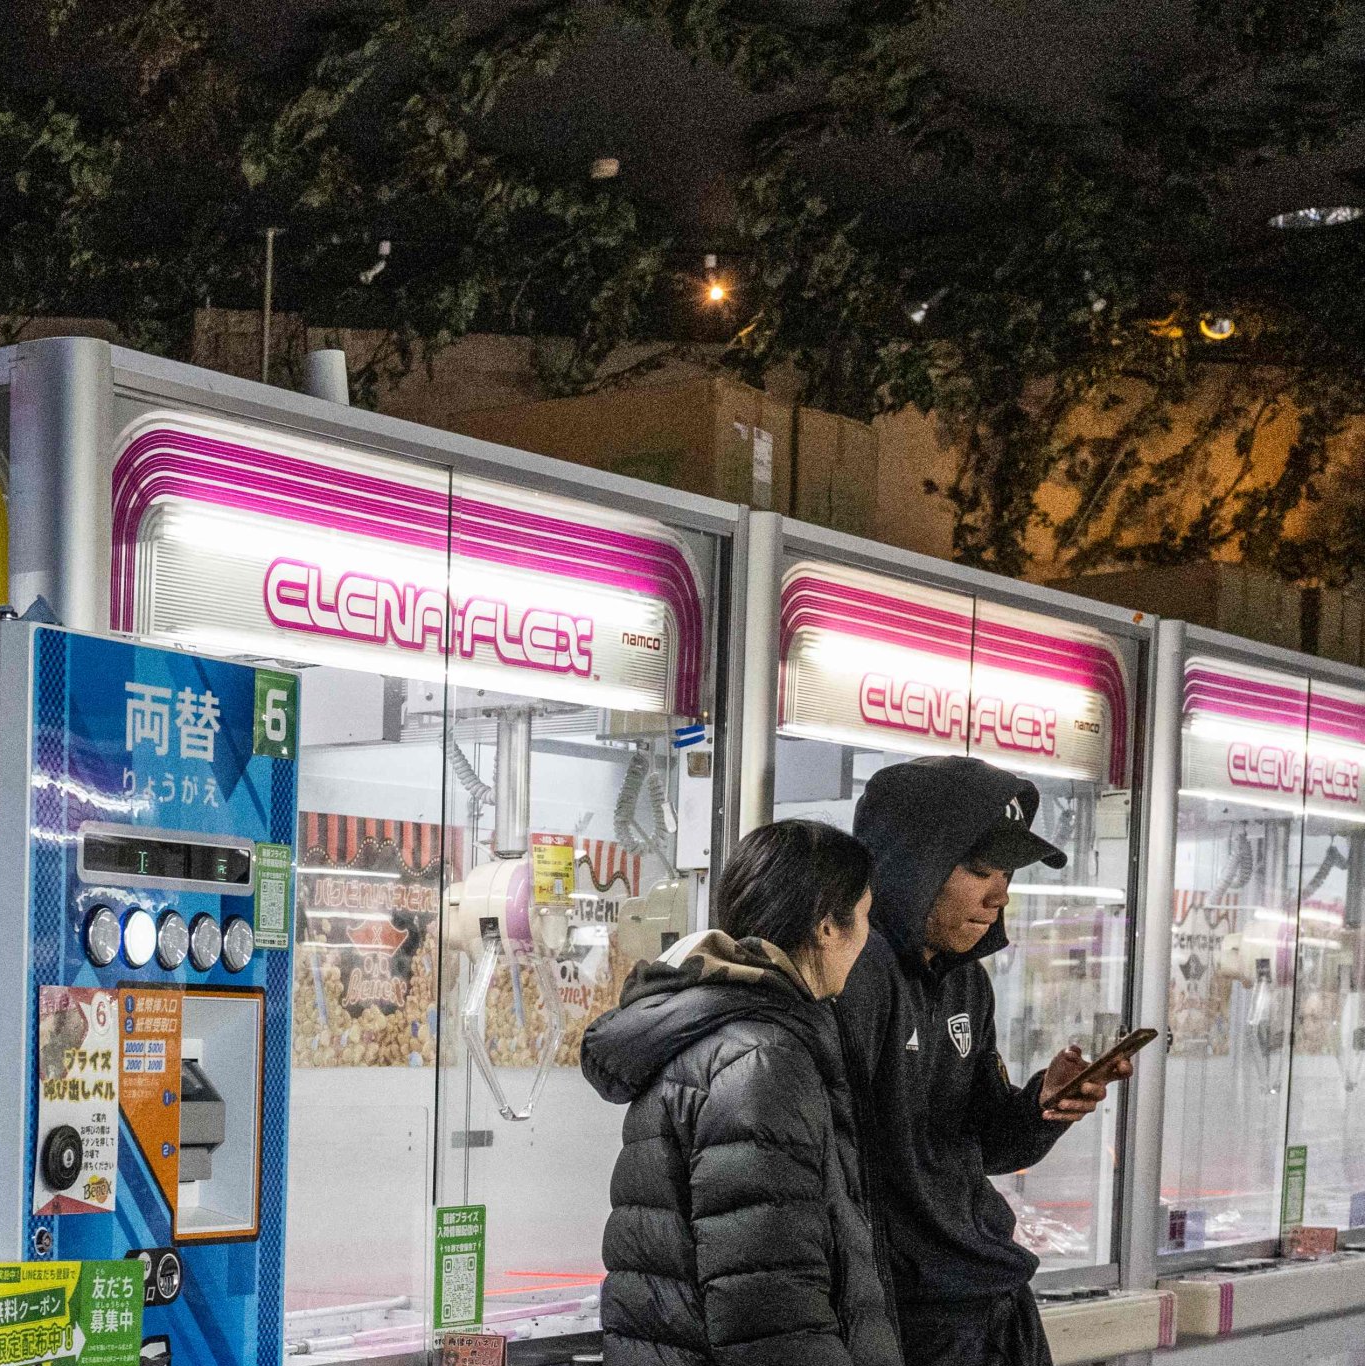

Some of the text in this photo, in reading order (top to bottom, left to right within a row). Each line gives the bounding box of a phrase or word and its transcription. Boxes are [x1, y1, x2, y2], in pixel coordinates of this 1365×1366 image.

[621, 631, 662, 652] namco
[124, 681, 221, 763] 両替
[265, 688, 288, 742] 6
[1073, 719, 1100, 734] namco
[122, 766, 219, 808] りょうがえ
[96, 1001, 107, 1027] 6
[125, 1042, 144, 1053] 10000
[64, 1049, 112, 1073] プライズ
[43, 1079, 116, 1101] 呼び出しベル
[91, 1275, 134, 1300] 友だち
[90, 1309, 134, 1334] 募集中
